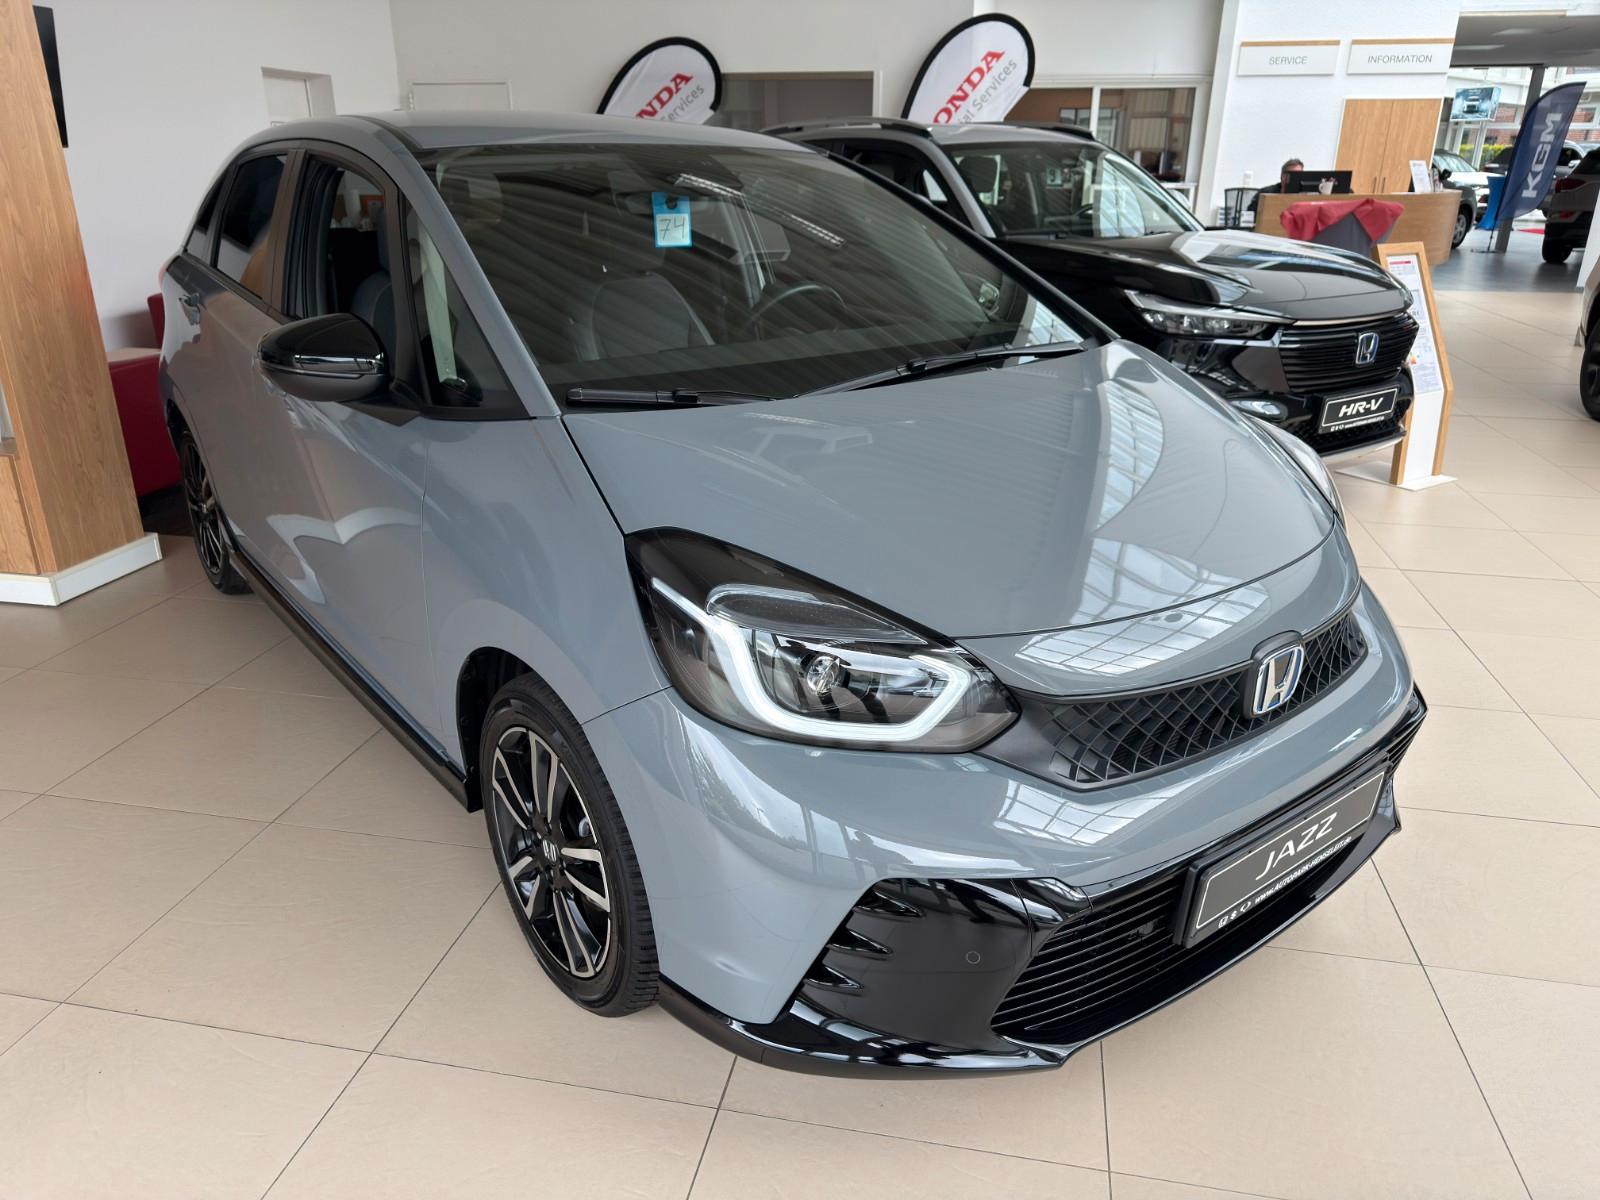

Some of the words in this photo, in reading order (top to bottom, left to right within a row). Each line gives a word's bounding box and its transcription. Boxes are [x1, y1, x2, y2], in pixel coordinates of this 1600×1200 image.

[1268, 56, 1308, 65] SERVICE
[1367, 54, 1433, 64] INFORMATION
[972, 59, 1017, 112] Services
[1521, 113, 1562, 198] KGM
[659, 215, 685, 241] 74
[1338, 397, 1384, 417] HR-V
[1255, 812, 1338, 880] JAZZ
